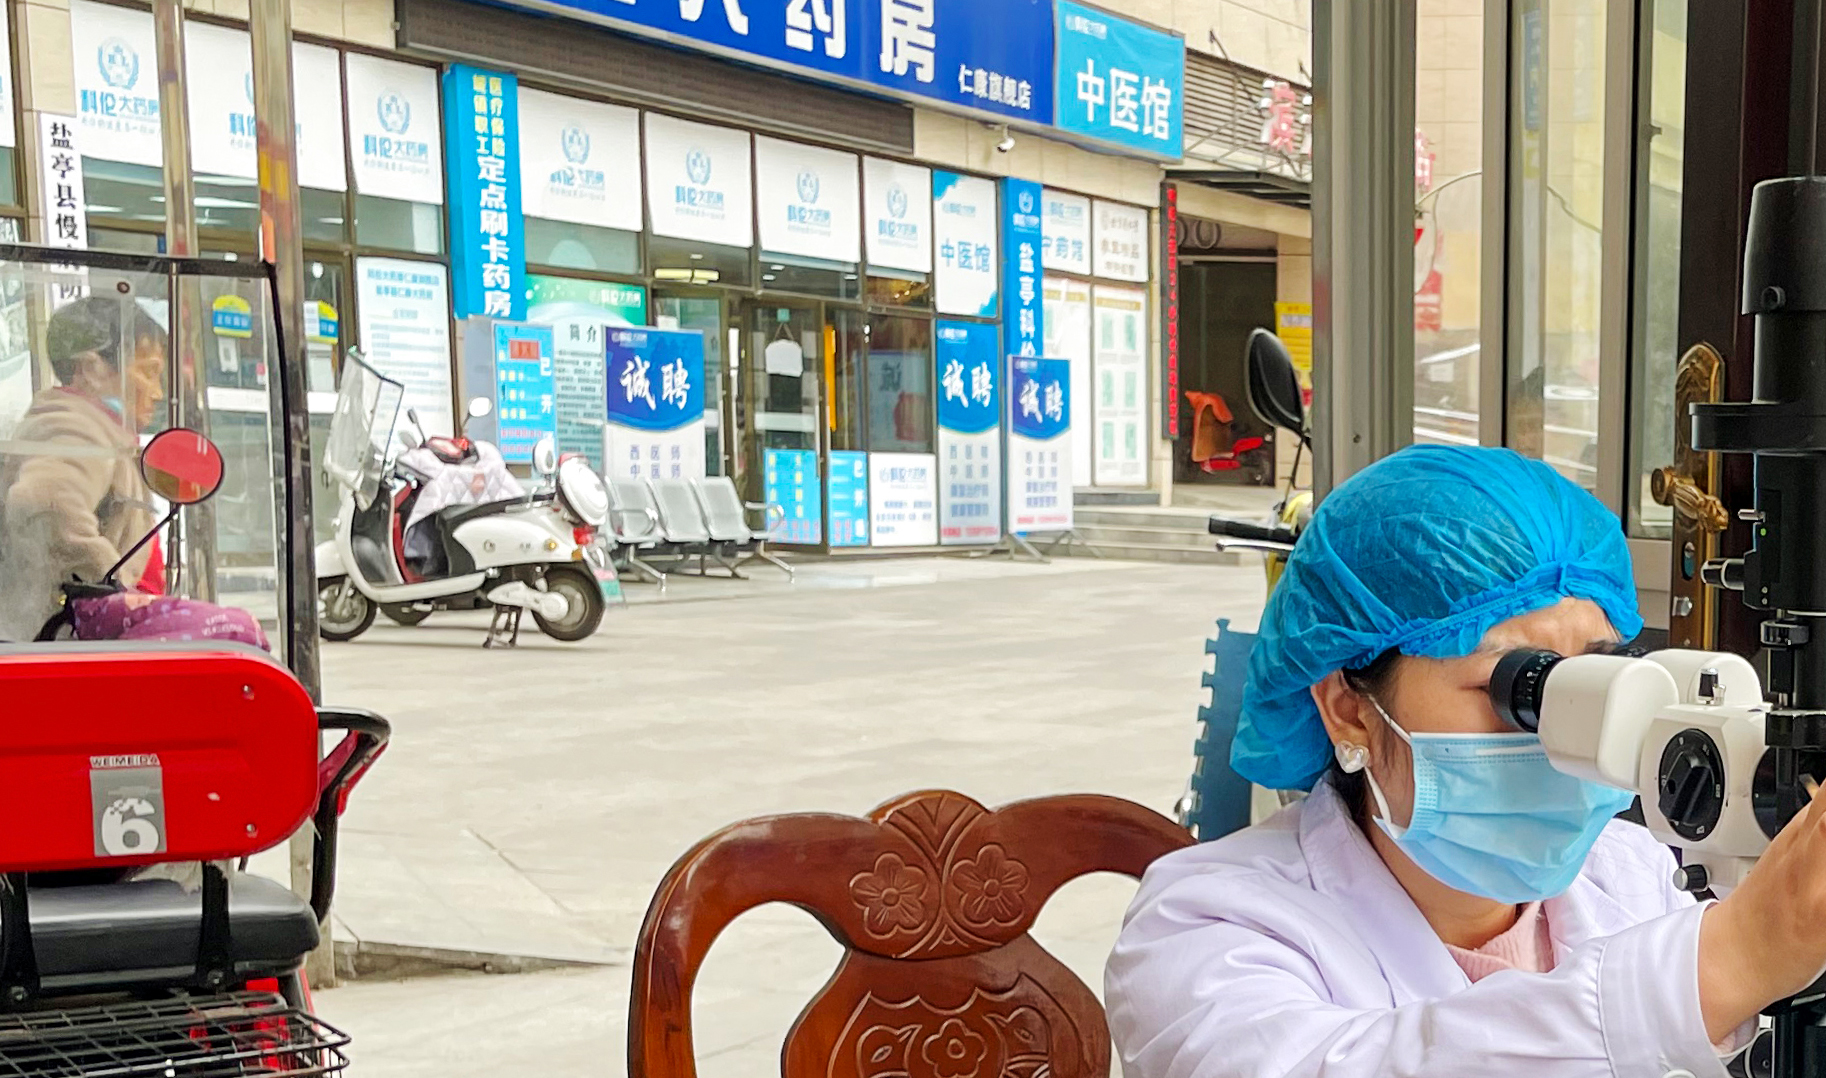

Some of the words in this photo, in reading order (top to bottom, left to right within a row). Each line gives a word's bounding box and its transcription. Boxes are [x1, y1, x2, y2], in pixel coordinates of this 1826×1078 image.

[958, 63, 1031, 110] 仁康旗舰店
[1077, 58, 1171, 140] 中医馆
[477, 155, 511, 317] 定点刷卡药房
[940, 238, 990, 272] 中医馆
[620, 355, 690, 411] 诚聘
[942, 359, 993, 408] 诚聘
[1019, 379, 1064, 424] 诚聘
[102, 798, 159, 855] 6
